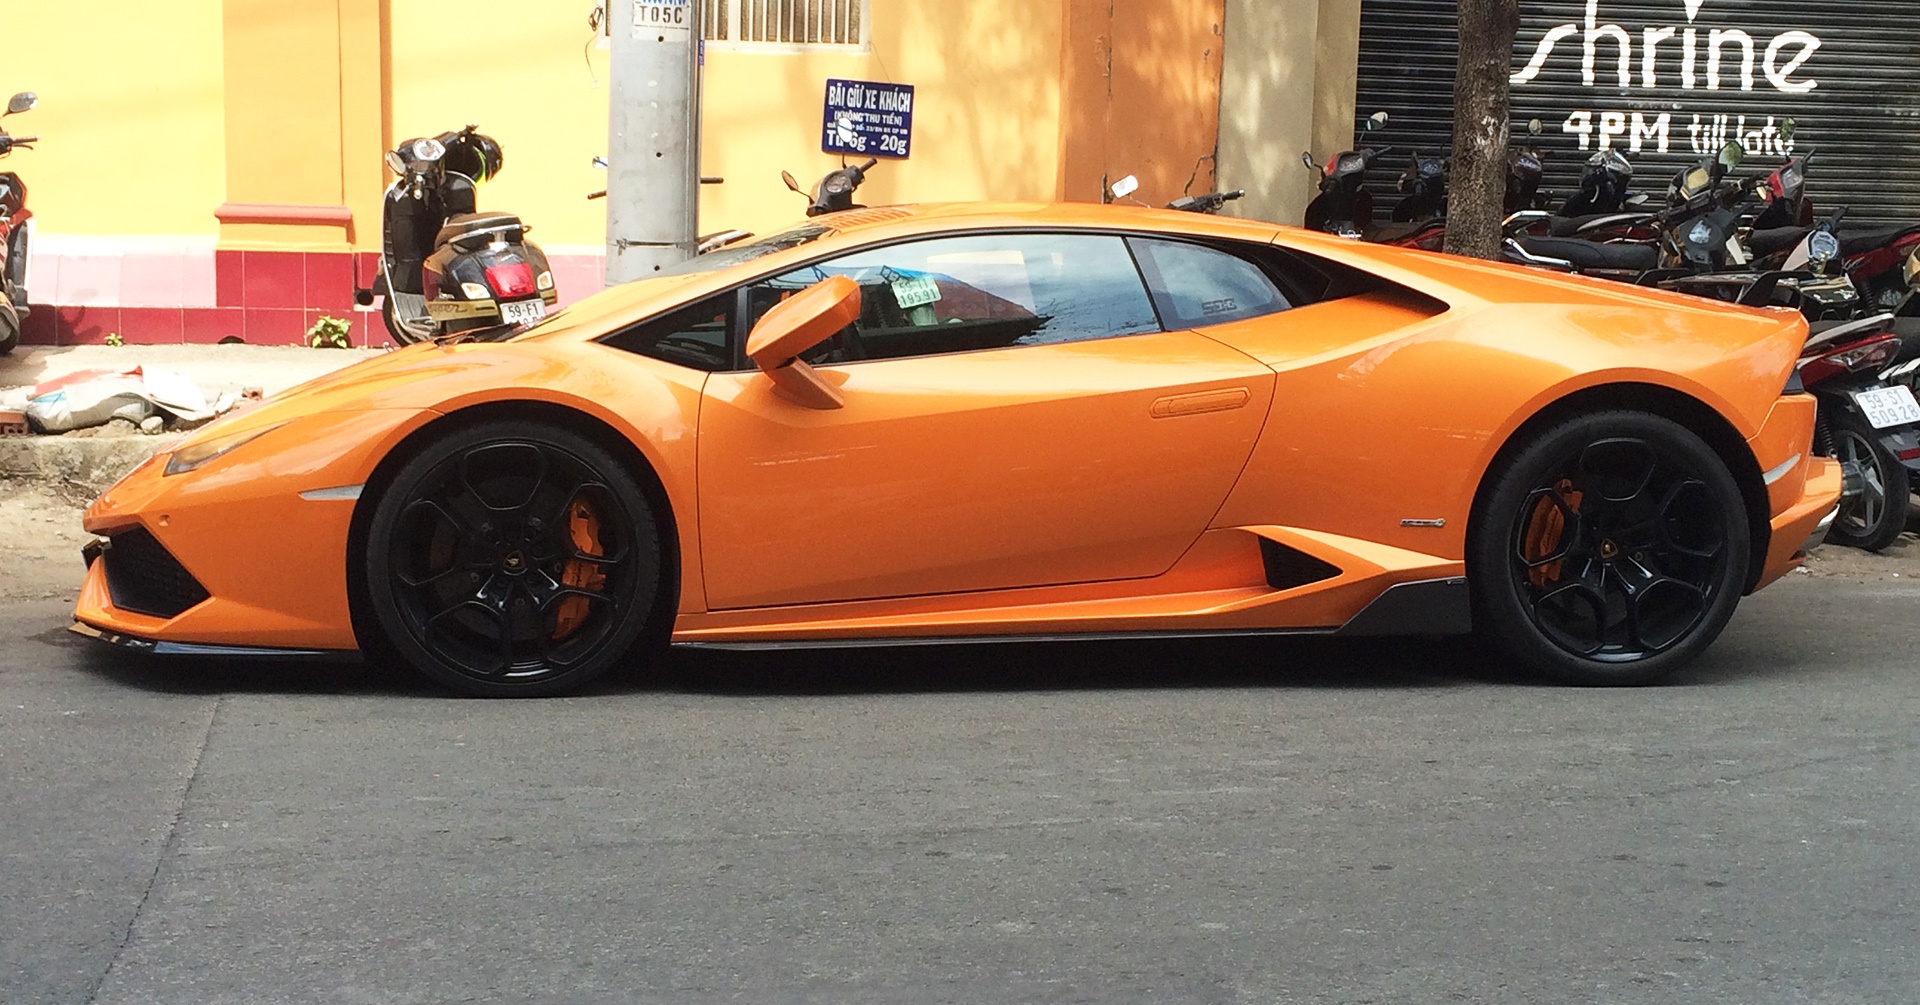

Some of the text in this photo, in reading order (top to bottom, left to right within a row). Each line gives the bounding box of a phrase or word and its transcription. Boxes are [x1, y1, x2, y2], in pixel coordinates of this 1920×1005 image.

[639, 5, 683, 24] T05C
[1508, 0, 1822, 93] shrine
[865, 89, 878, 110] XE
[879, 87, 911, 113] KHÁCH
[864, 113, 881, 124] THU
[1562, 111, 1671, 154] 4PM
[1686, 114, 1728, 154] till
[880, 134, 907, 155] 20g
[508, 303, 539, 318] 59-F1
